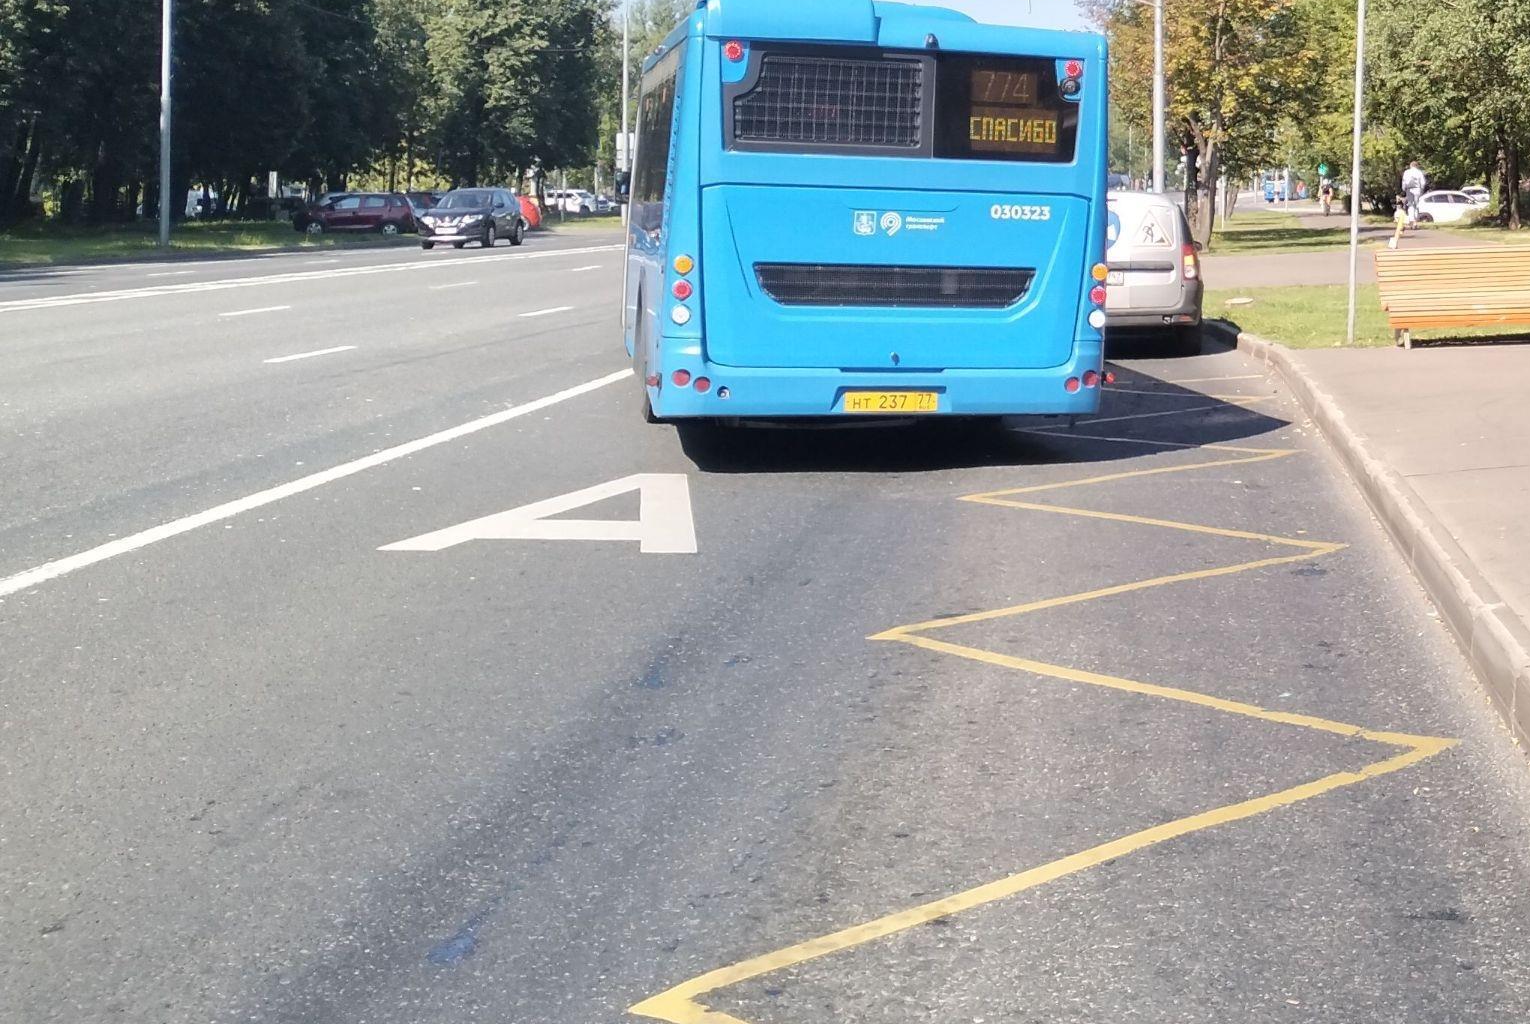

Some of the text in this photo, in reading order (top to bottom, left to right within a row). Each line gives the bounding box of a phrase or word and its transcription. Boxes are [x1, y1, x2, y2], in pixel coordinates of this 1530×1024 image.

[980, 70, 1030, 102] 774
[969, 116, 1057, 144] СПАСИБО
[991, 204, 1051, 220] 030323
[879, 394, 908, 409] 237
[918, 393, 932, 406] 77
